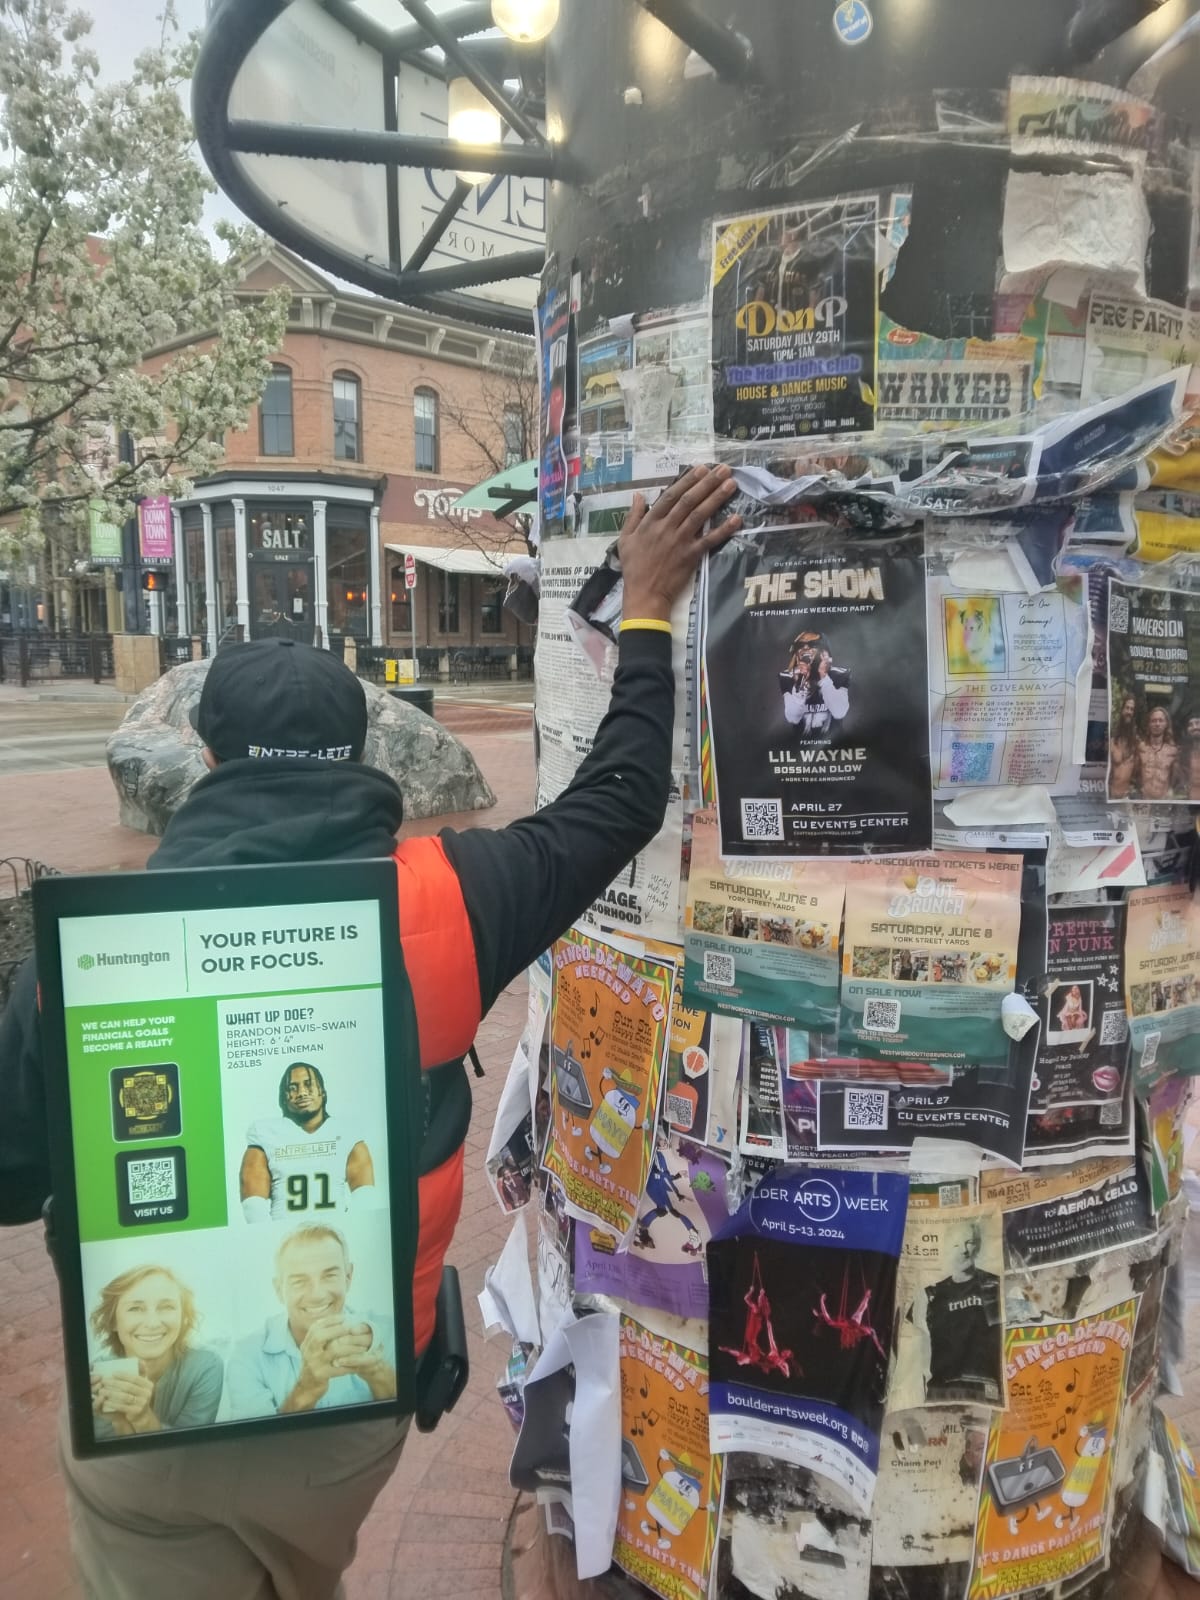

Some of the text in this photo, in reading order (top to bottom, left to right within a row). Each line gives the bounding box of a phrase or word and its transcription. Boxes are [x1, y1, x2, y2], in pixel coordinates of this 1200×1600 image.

[735, 300, 816, 337] Don
[1089, 302, 1129, 329] PRE
[1131, 308, 1184, 340] PARTY
[746, 329, 841, 353] SATURDAY JULY 29TH
[736, 376, 848, 401] HOUSE & DANCE MUSIC
[877, 372, 1011, 404] WANTED
[144, 508, 167, 524] DOWN
[145, 524, 167, 540] TOWN
[262, 529, 301, 549] SALT
[809, 557, 847, 566] PRESENTS
[743, 566, 885, 607] THE SHOW
[765, 608, 790, 617] PRIME
[790, 607, 809, 615] TIME
[809, 606, 849, 615] WEEKEND
[850, 604, 876, 613] PARTY
[1155, 648, 1188, 661] COLORADO
[965, 683, 1049, 693] THE GIVEAWAY
[768, 747, 867, 763] LIL WAYNE
[773, 764, 862, 775] BOSSMAN DLOW
[790, 803, 843, 812] APRIL 27
[792, 817, 910, 830] CU EVENTS CENTER
[875, 857, 1020, 872] DISCOUNTED TICKETS HERE!
[709, 880, 819, 908] SATURDAY, JUNE 8
[728, 894, 796, 912] YORK STREET YARDS
[887, 894, 965, 918] BRUNCH
[199, 924, 359, 950] YOUR FUTURE IS
[870, 922, 993, 939] SATURDAY, JUNE 8
[689, 937, 753, 957] ON SALE NOW!
[893, 935, 970, 946] YORK STREET YARDS
[1067, 935, 1115, 953] PUNK
[96, 949, 170, 970] Huntington
[200, 951, 324, 974] OUR FOCUS.
[555, 943, 592, 971] CINCO
[594, 947, 616, 971] DE
[615, 963, 665, 1022] MAYO
[574, 963, 632, 1005] WEEKEND
[848, 985, 922, 998] ON SALE NOW!
[81, 1015, 176, 1031] WE CAN HELP YOUR
[225, 1007, 315, 1026] WHAT UP DOE?
[82, 1027, 169, 1043] FINANCIAL GOALS
[226, 1019, 358, 1040] BRANDON DAVIS-SWAIN
[82, 1037, 174, 1053] BECOME A REALITY
[226, 1036, 266, 1049] HEIGHT:
[226, 1043, 324, 1060] DEFENSIVE LINEMAN
[227, 1058, 263, 1070] 263LBS
[897, 1095, 950, 1106] APRIL 27
[897, 1111, 1010, 1129] CU EVENTS CENTER
[583, 1164, 616, 1195] PARTY
[1033, 1178, 1048, 1189] 23
[286, 1172, 336, 1212] 91
[793, 1191, 832, 1208] ARTS
[843, 1196, 889, 1212] WEEK
[1056, 1194, 1104, 1217] AERIAL
[1104, 1181, 1139, 1202] CELLO
[134, 1205, 174, 1218] VISIT US
[761, 1217, 787, 1232] April
[818, 1227, 846, 1240] 2024
[921, 1234, 939, 1243] on
[948, 1294, 983, 1313] truth
[1006, 1331, 1070, 1381] CINCO
[1095, 1320, 1131, 1351] MAYO
[1039, 1340, 1106, 1371] WEEKEND
[727, 1391, 849, 1440] boulderartsweek.org
[635, 1537, 678, 1569] PARTY
[1002, 1542, 1046, 1563] DANCE
